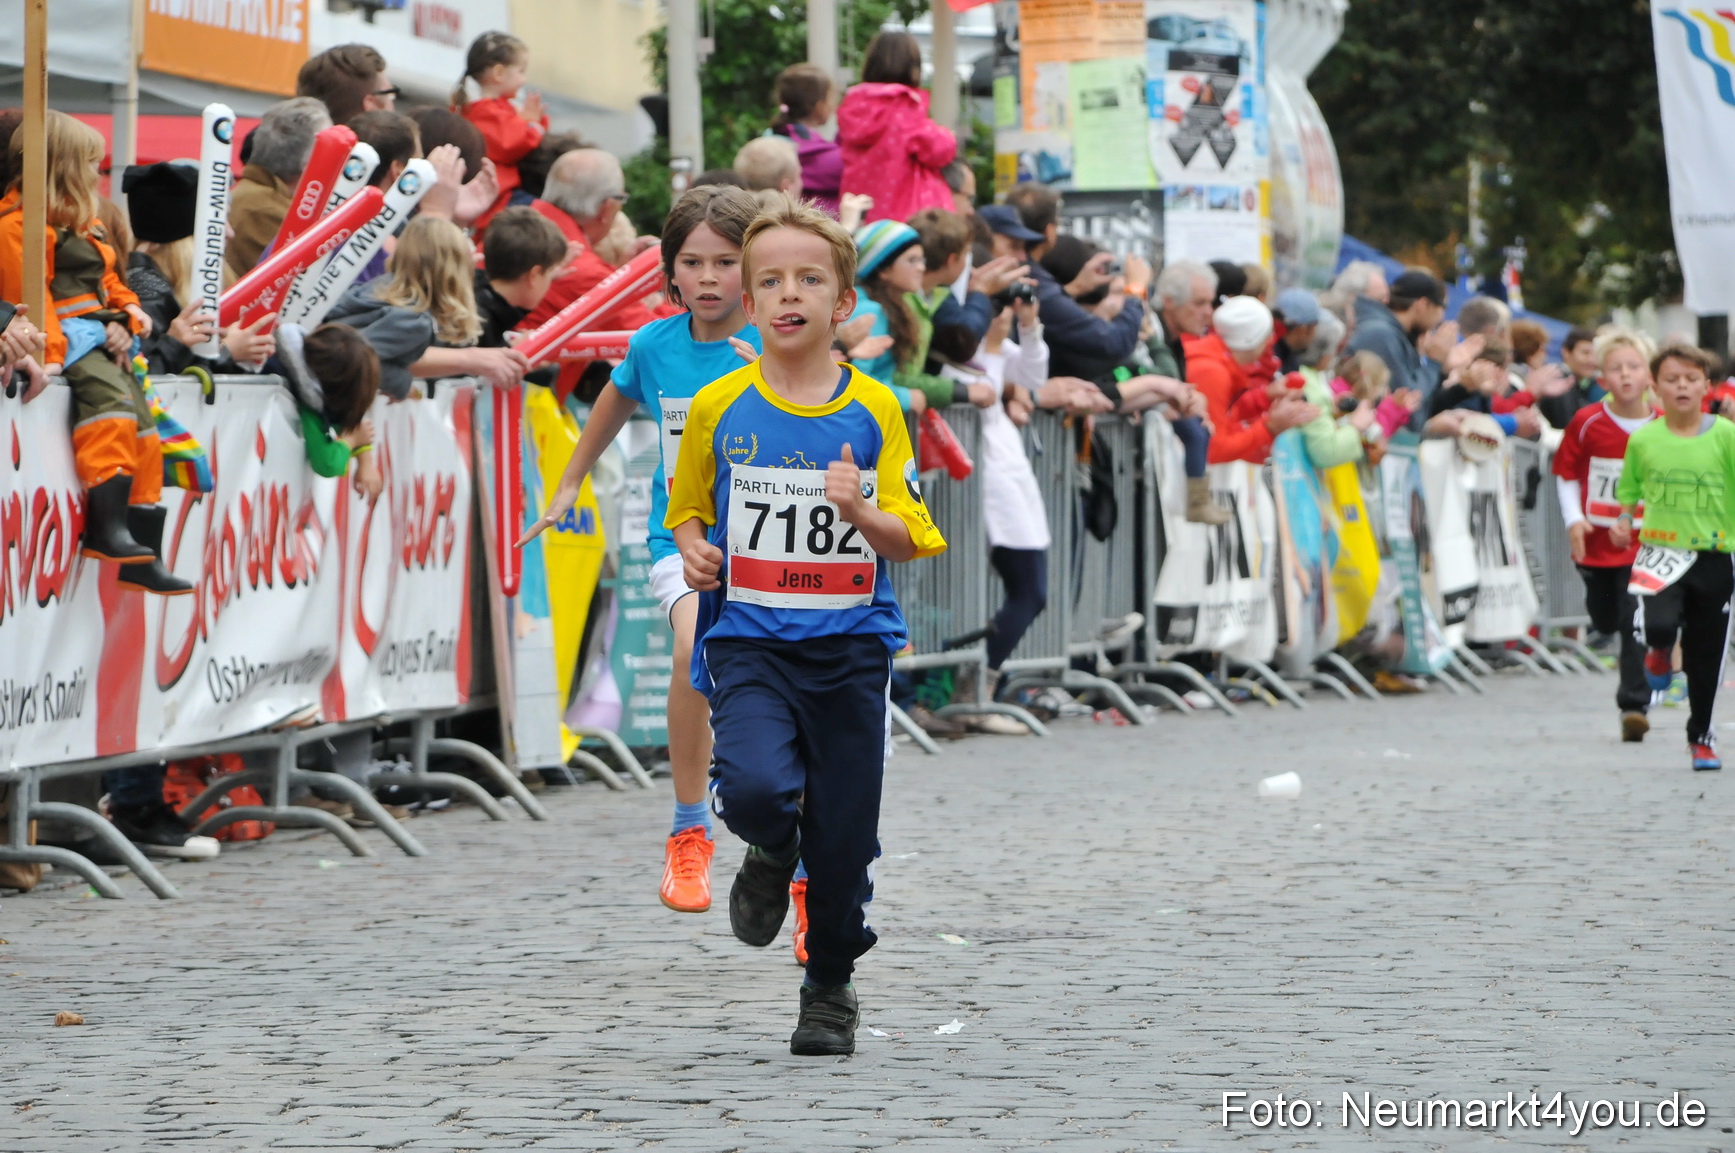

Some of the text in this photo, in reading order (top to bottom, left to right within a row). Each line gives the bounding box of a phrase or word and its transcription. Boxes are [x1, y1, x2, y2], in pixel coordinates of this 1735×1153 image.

[734, 436, 744, 444] 15
[728, 447, 749, 457] Jahre
[734, 478, 826, 498] PARTL Neum
[744, 501, 862, 556] 7182
[777, 568, 823, 589] Jens
